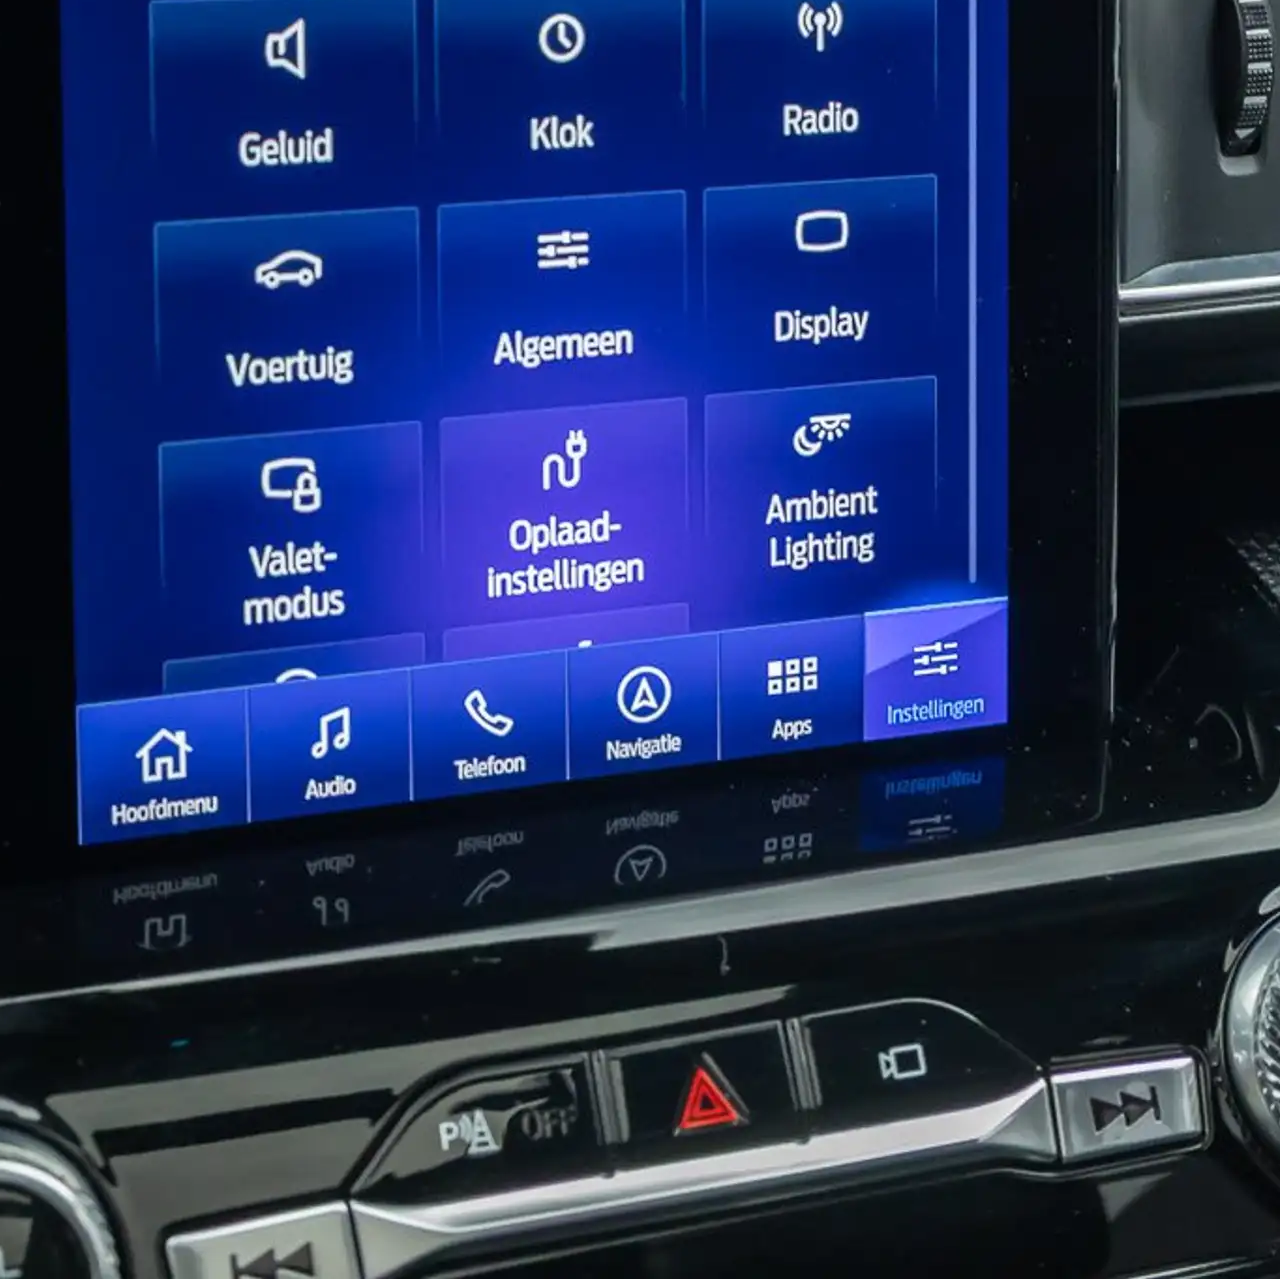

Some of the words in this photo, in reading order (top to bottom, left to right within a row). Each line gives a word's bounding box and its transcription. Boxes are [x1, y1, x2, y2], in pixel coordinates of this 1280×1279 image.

[530, 114, 595, 151] Klok
[783, 101, 859, 136] Radio
[239, 127, 333, 167] Geluid
[774, 305, 869, 345] Display
[225, 346, 354, 387] Voertuig
[493, 329, 633, 368] Algemeen
[765, 485, 878, 525] Ambient
[509, 510, 622, 555] Oplaad-
[770, 530, 875, 570] Lighting
[248, 541, 338, 578] Valet-
[487, 558, 644, 598] instellingen
[243, 585, 345, 626] modus
[771, 718, 813, 741] Apps
[887, 697, 985, 725] Instellingen
[606, 733, 682, 761] Navigatie
[453, 754, 526, 780] Telefoon
[304, 775, 357, 801] Audio
[111, 795, 218, 826] Hoofdmenu
